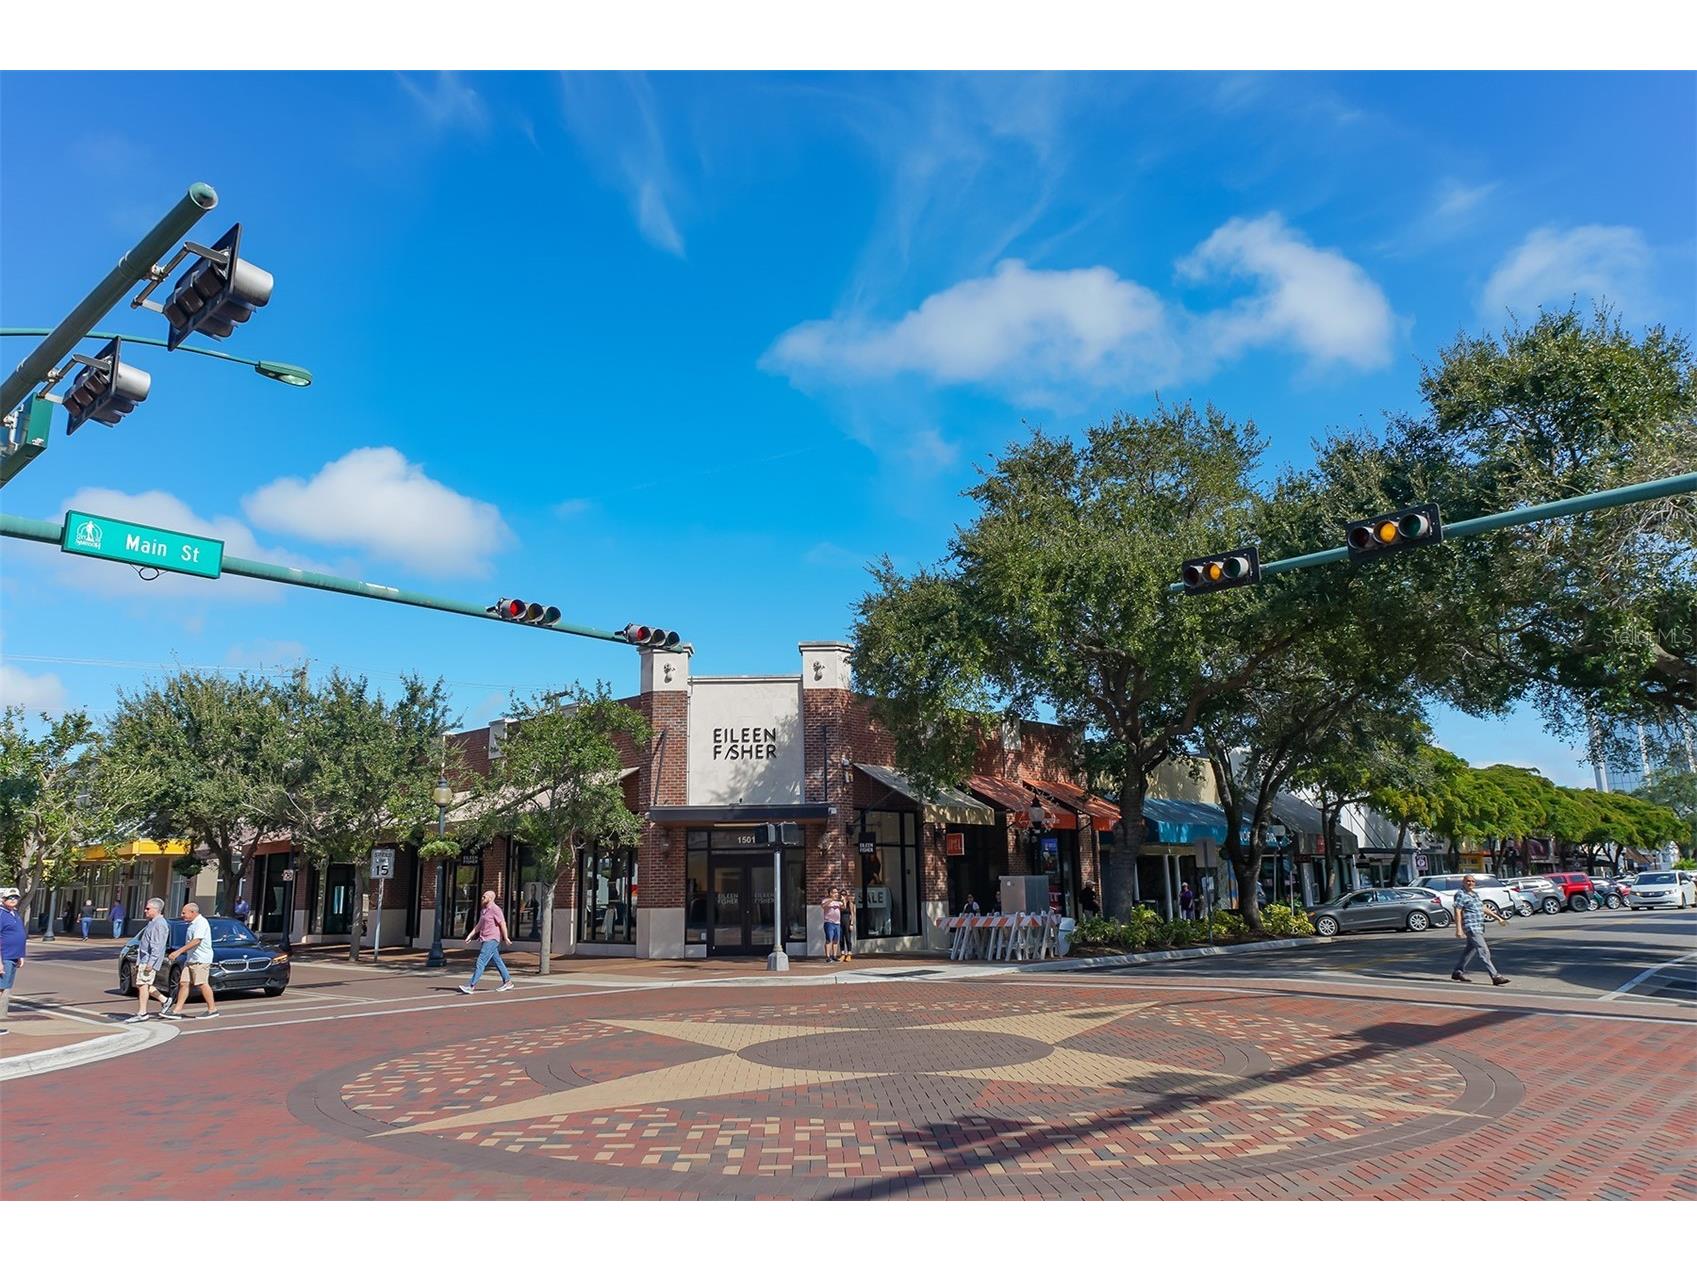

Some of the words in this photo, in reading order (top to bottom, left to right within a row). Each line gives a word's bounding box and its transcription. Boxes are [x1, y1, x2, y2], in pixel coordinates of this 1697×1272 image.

[125, 533, 167, 557] Main
[181, 544, 200, 563] St
[713, 728, 776, 743] EILEEN
[738, 836, 756, 844] 1501
[376, 865, 389, 876] 15
